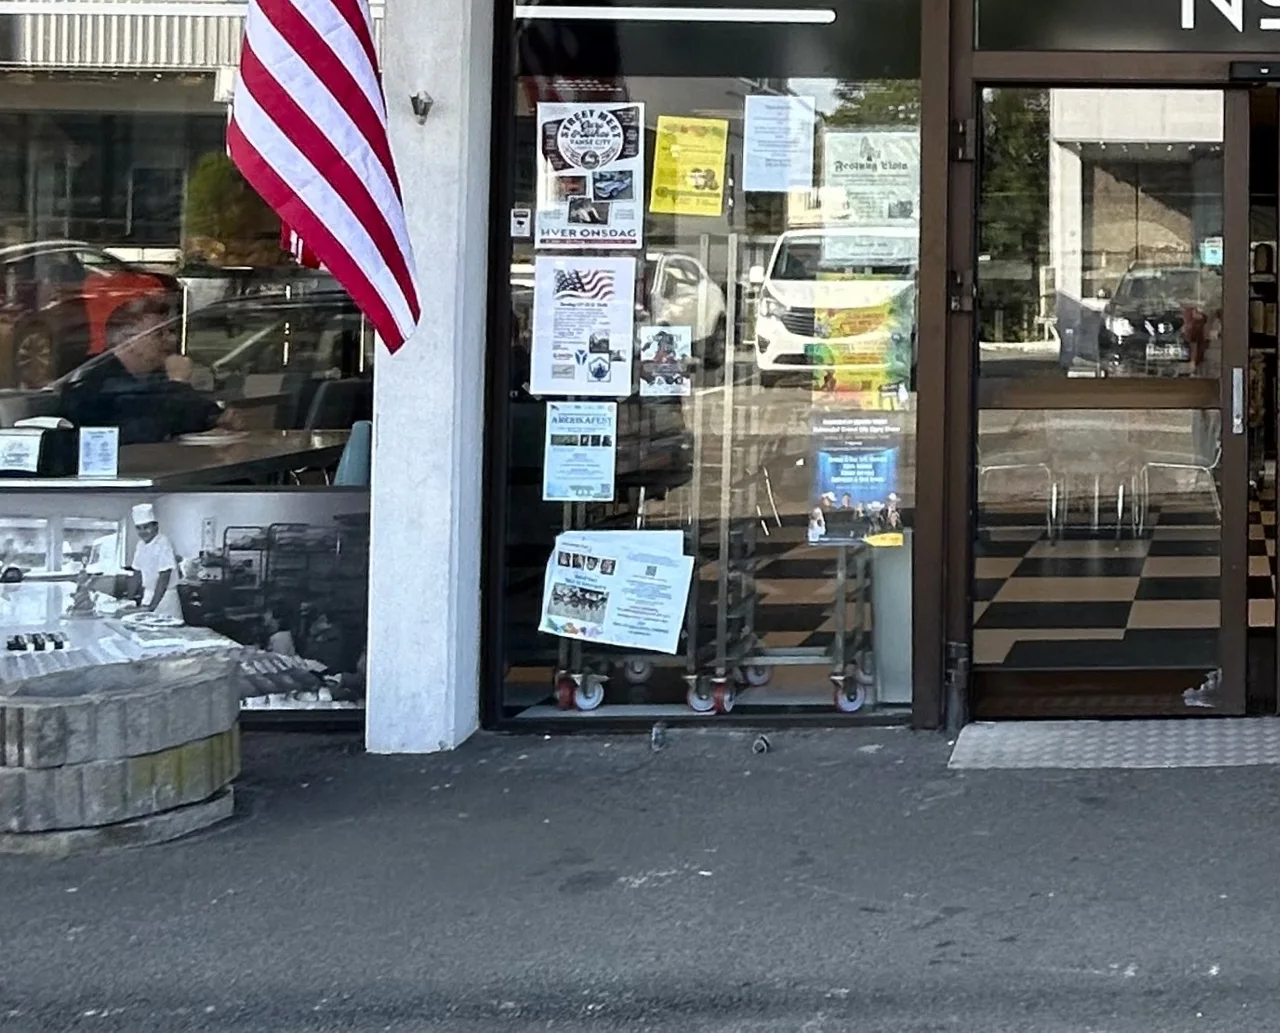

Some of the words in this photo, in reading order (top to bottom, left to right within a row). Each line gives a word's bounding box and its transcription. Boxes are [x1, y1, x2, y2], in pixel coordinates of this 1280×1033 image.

[561, 109, 596, 138] STREET
[598, 111, 621, 138] MEET
[541, 229, 577, 237] HVER
[580, 228, 637, 238] ONSDAG
